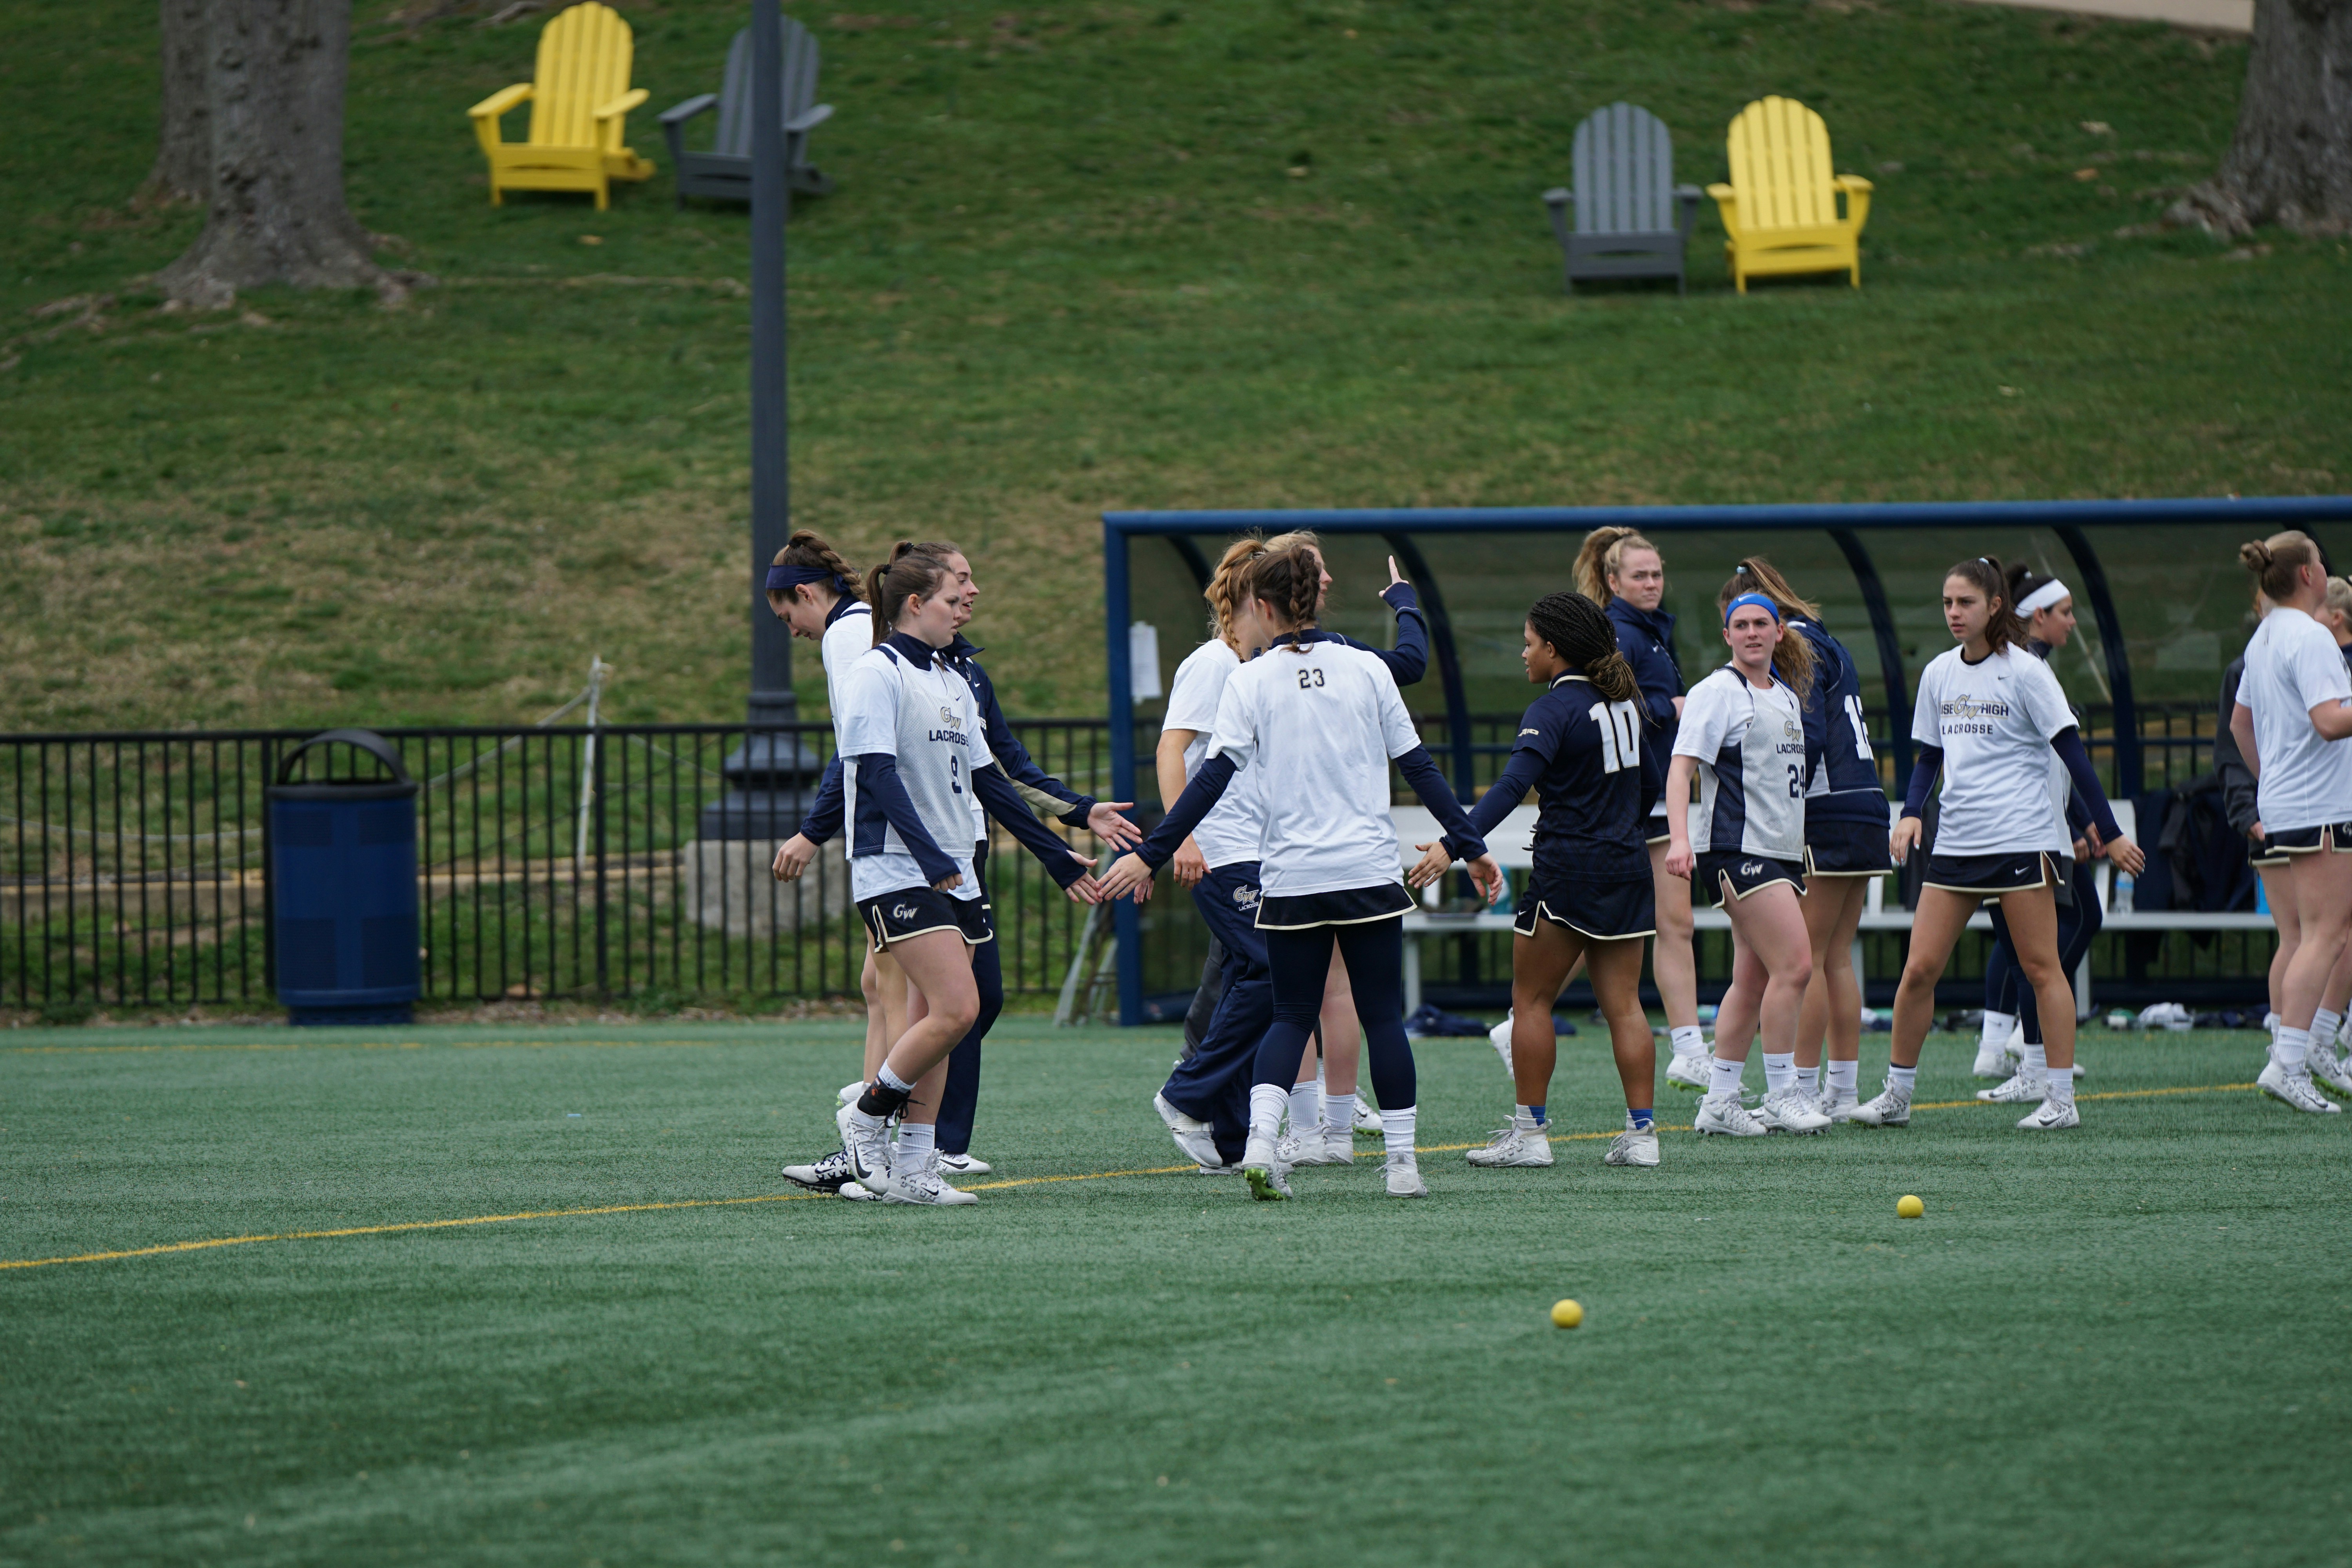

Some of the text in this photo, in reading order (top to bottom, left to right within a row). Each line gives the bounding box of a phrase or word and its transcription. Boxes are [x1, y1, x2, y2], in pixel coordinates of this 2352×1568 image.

[1297, 668, 1325, 690] 23
[1941, 693, 2009, 720] ISE GW HIGH
[940, 707, 962, 730] GW
[1942, 723, 1993, 735] LACROSSE
[929, 730, 969, 747] LACROSS
[1589, 699, 1640, 774] 10
[1784, 720, 1802, 742] GW
[951, 755, 962, 793] 9
[1788, 764, 1805, 799] 24
[1740, 860, 1764, 877] GW
[1233, 884, 1259, 905] GW
[893, 902, 919, 921] GW
[1239, 902, 1259, 911] LACROSSE
